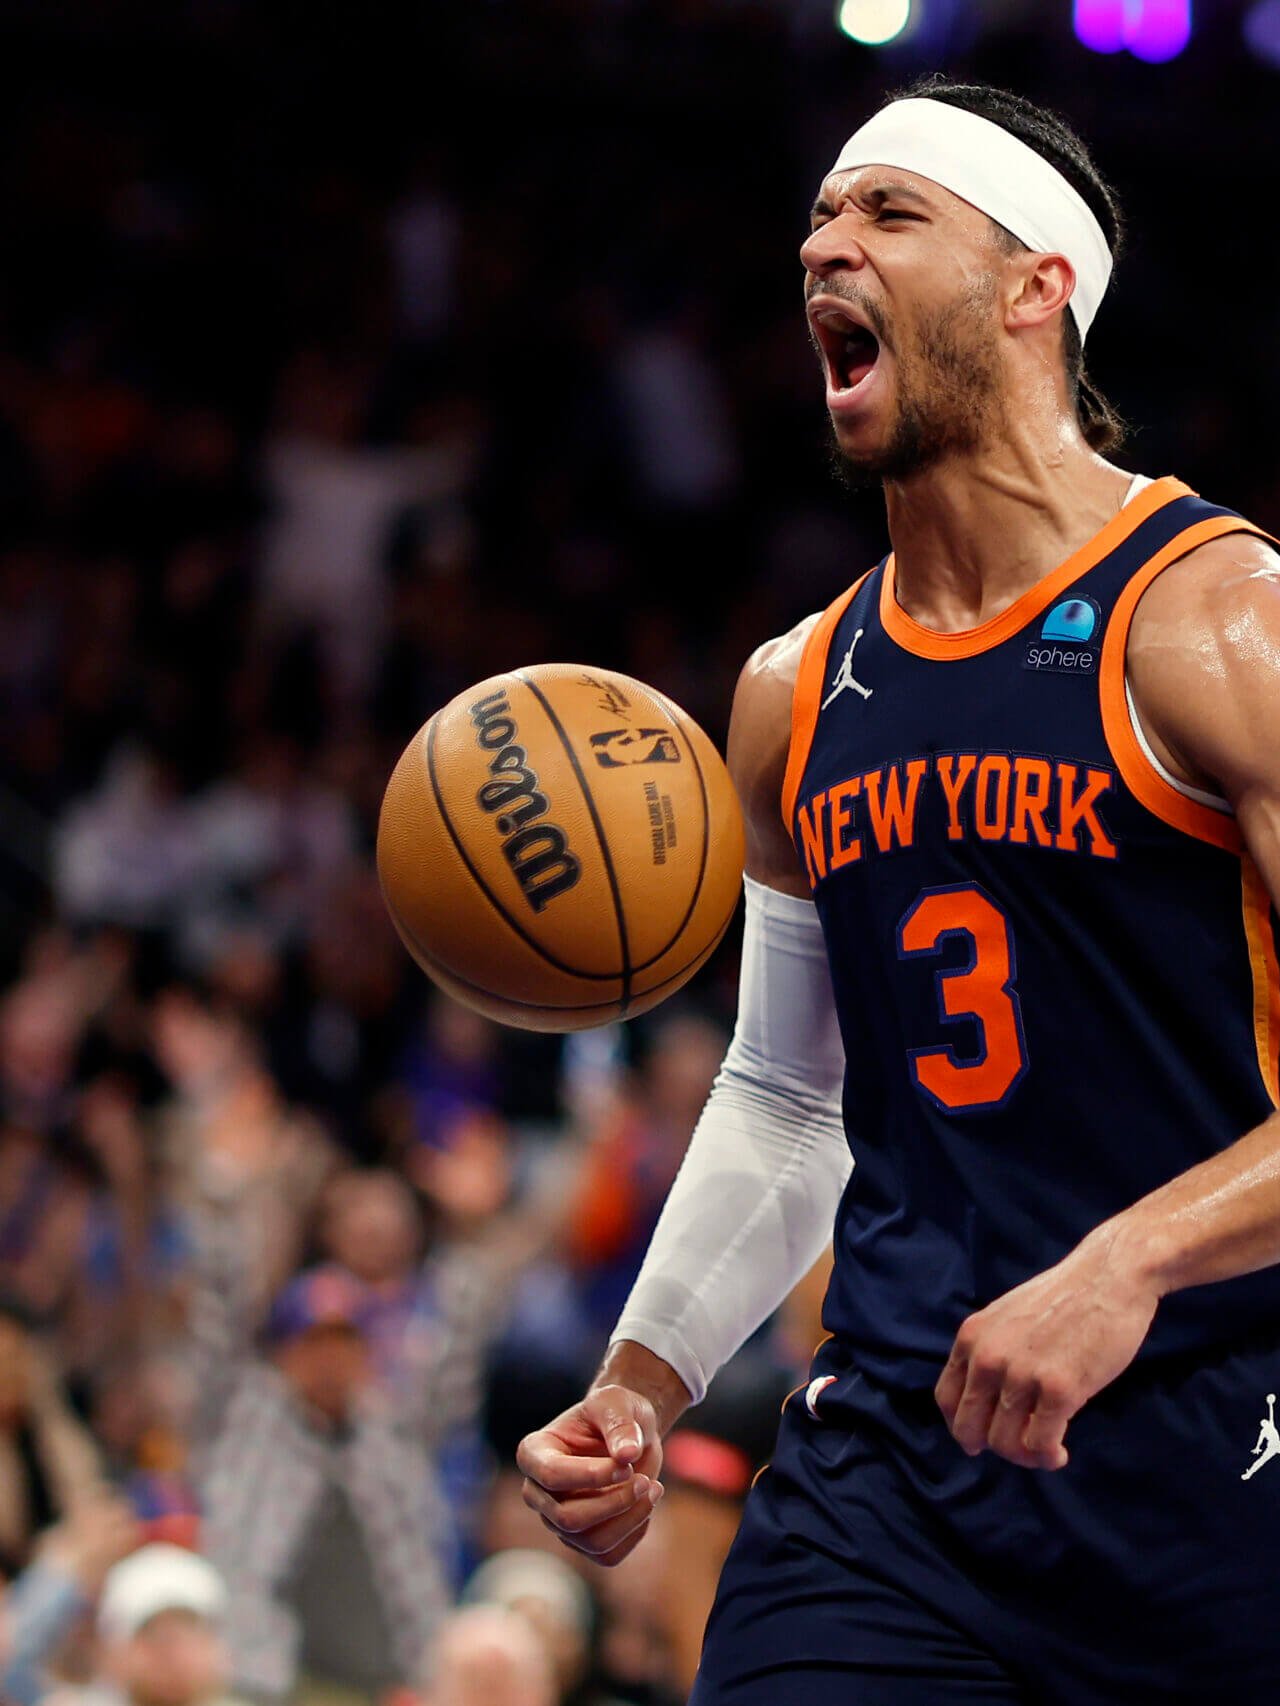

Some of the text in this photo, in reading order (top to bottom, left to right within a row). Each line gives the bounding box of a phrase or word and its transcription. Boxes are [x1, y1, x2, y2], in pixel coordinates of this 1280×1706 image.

[1027, 646, 1093, 669] sphere
[469, 689, 582, 914] Wilson
[797, 757, 929, 892] NEW
[935, 752, 1119, 860] YORK
[899, 884, 1028, 1112] 3
